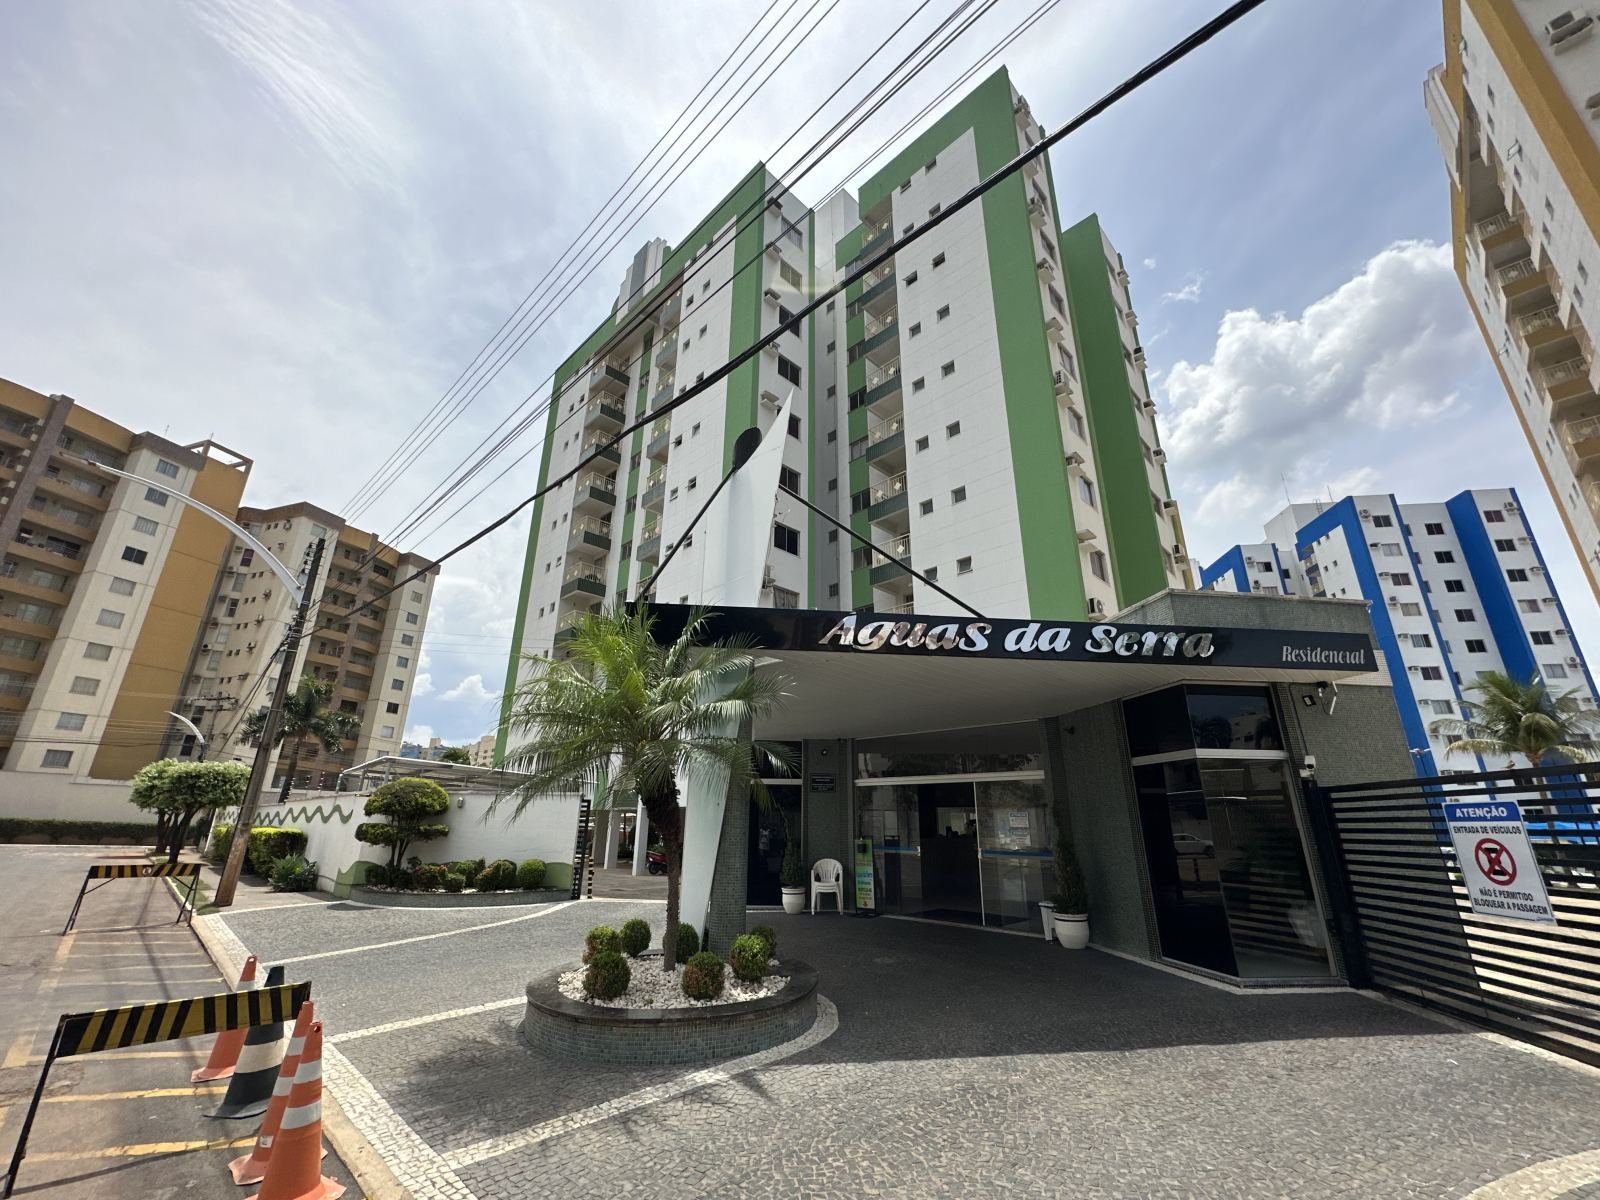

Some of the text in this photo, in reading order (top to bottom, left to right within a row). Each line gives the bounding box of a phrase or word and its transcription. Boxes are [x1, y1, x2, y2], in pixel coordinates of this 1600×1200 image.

[1004, 622, 1071, 652] da
[1085, 625, 1214, 658] Serra
[1456, 806, 1507, 819] ATENÇÃO
[1453, 824, 1521, 834] ENTRADA DE VEÍCULOS
[1480, 887, 1492, 897] NÃO
[1499, 890, 1533, 901] PERMITIDO
[1473, 898, 1548, 914] BLOQUEAR A PASSAGEM
